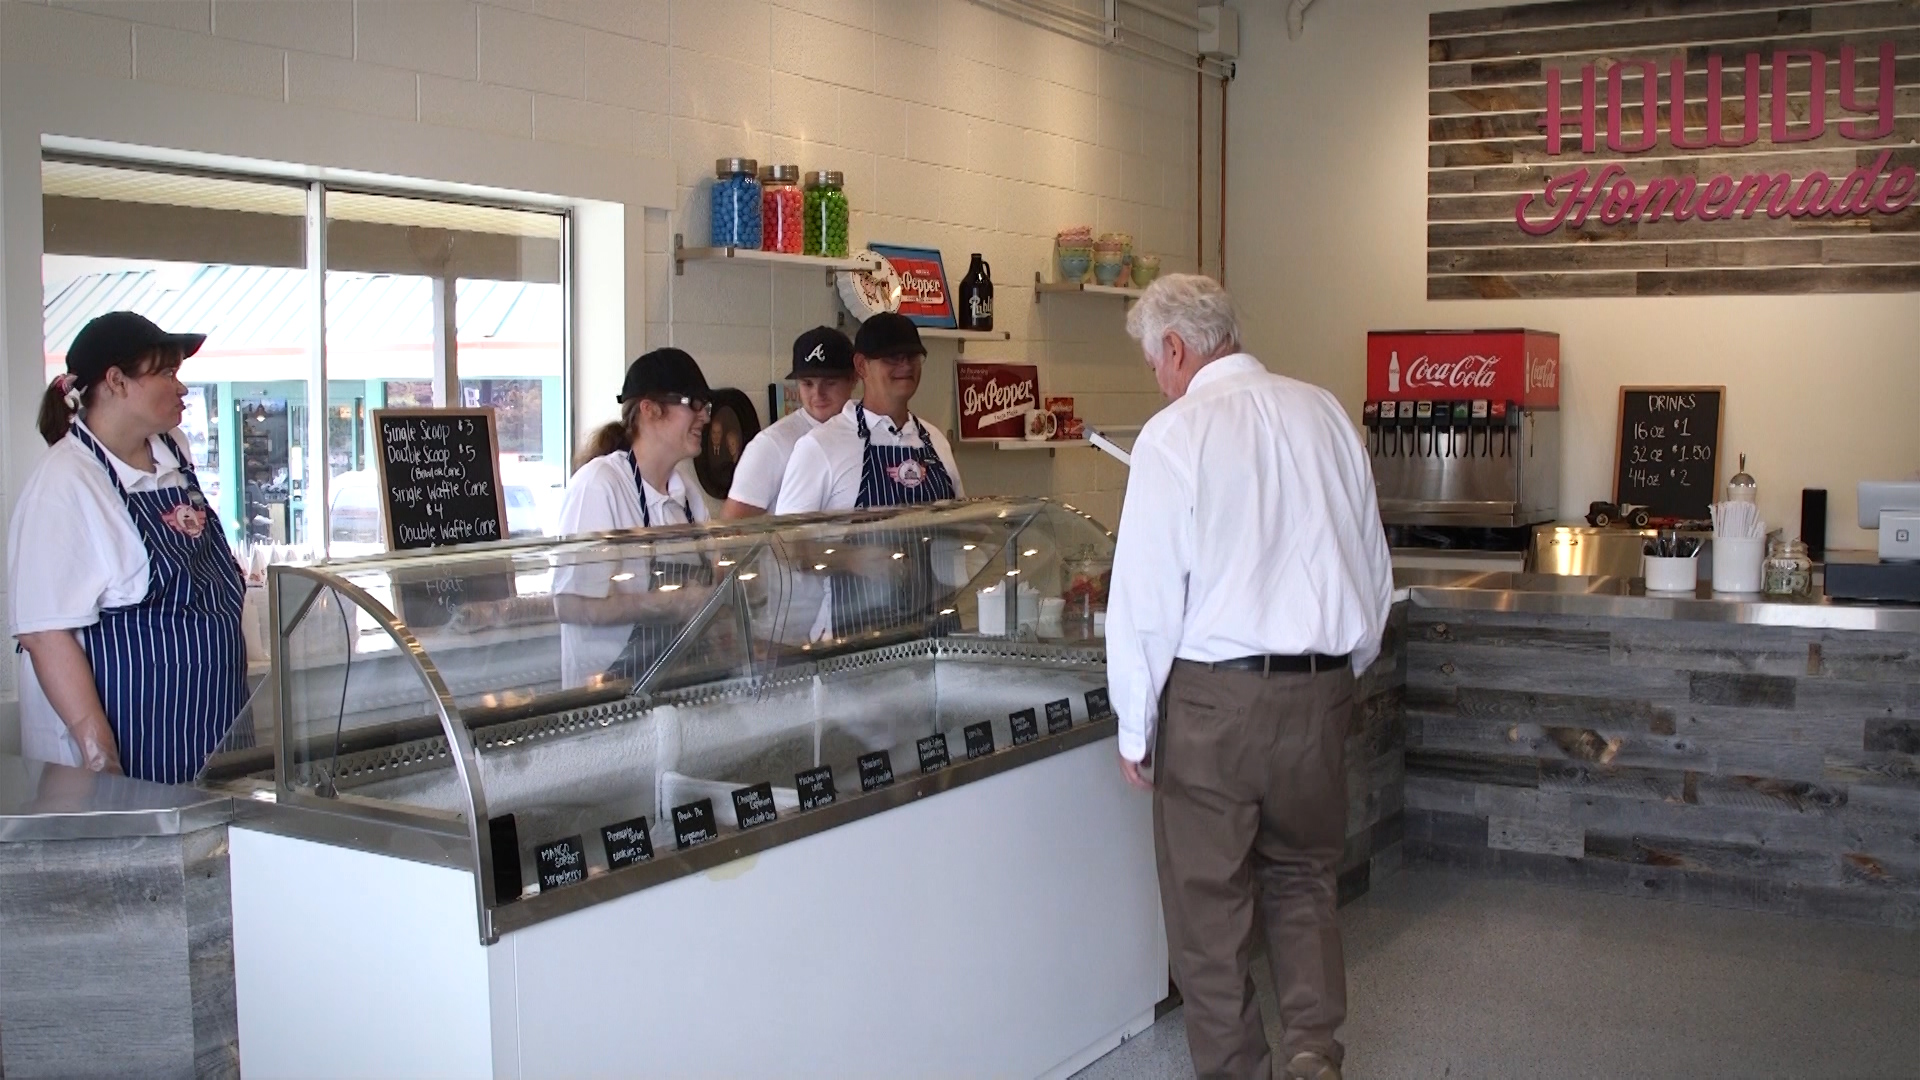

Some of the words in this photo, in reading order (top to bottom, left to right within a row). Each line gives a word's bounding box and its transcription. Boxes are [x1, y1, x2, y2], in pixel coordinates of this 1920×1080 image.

[1536, 41, 1896, 156] HOWDY
[1516, 148, 1919, 235] Homemade
[964, 384, 984, 416] Dr
[985, 378, 1033, 411] Pepper
[1649, 393, 1696, 413] DRINKS
[383, 420, 417, 445] Single
[420, 419, 450, 446] Scoop
[1634, 421, 1648, 440] 16
[1650, 425, 1666, 438] oz
[387, 445, 422, 465] Double
[423, 443, 450, 467] Scoop
[1630, 445, 1648, 464] 32
[1650, 449, 1663, 462] oz
[1628, 468, 1646, 488] 44
[1646, 473, 1661, 486] oz
[392, 485, 423, 508] Single
[427, 480, 460, 500] Waffle
[464, 479, 490, 497] Cone
[399, 522, 437, 543] Double
[440, 519, 473, 540] Waffle
[474, 517, 497, 536] Cone
[540, 843, 570, 861] MANGO
